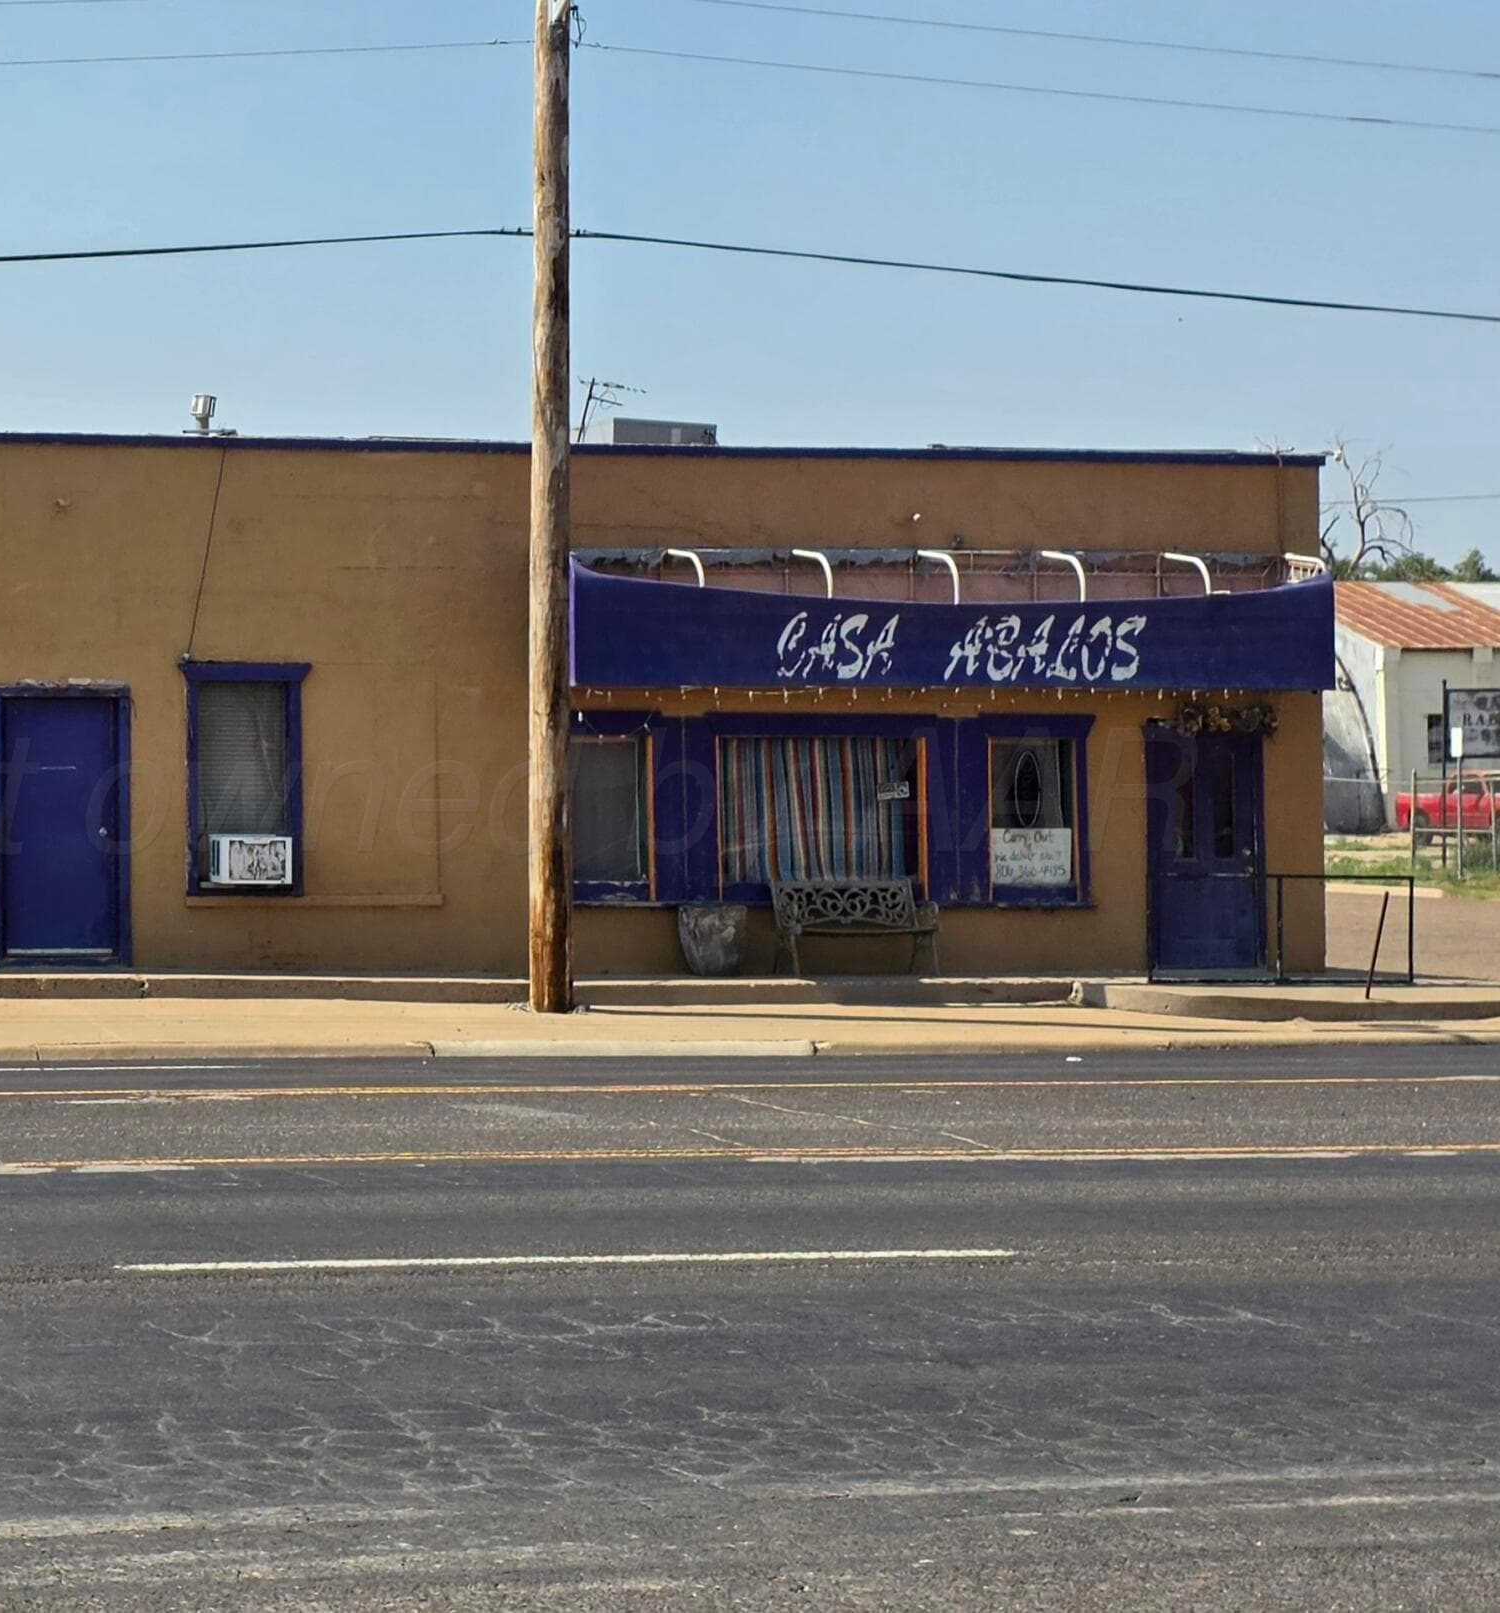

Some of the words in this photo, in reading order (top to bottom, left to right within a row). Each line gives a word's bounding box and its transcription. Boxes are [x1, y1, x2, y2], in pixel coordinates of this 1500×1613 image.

[776, 611, 900, 680] CASA
[944, 613, 1148, 681] ABALOS
[1034, 830, 1054, 844] Out
